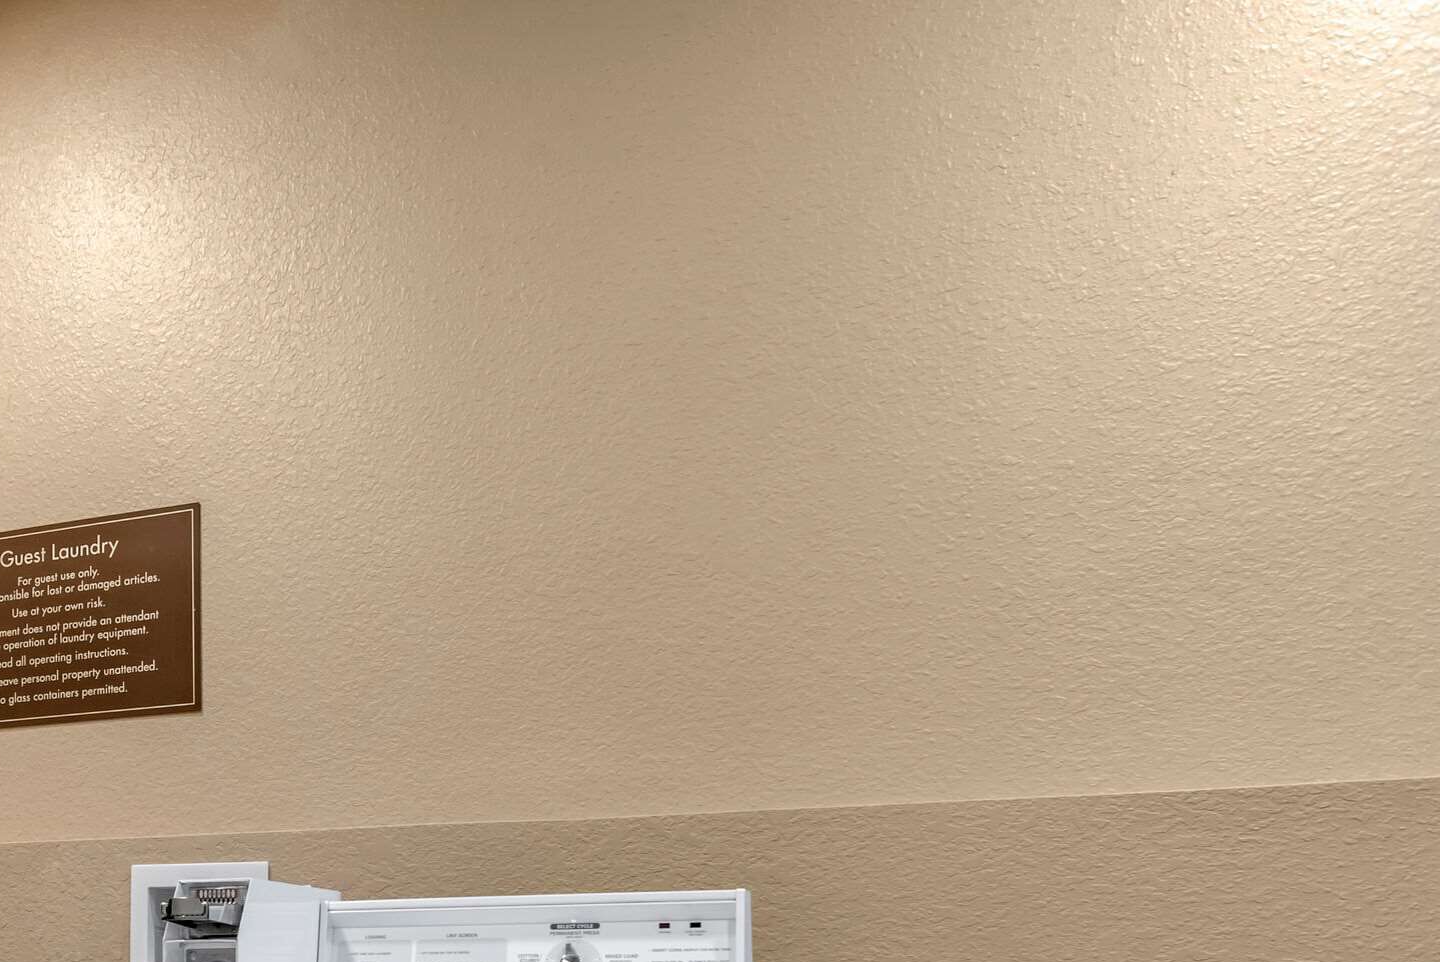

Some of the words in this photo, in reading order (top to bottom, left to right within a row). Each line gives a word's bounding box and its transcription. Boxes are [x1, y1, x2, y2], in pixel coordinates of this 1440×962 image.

[0, 547, 46, 568] Guest
[52, 535, 119, 560] Laundry
[17, 576, 32, 587] For
[34, 572, 58, 585] guest
[60, 572, 75, 580] use
[78, 566, 99, 580] only.
[32, 587, 44, 597] for
[47, 585, 62, 595] lost
[77, 576, 120, 591] damaged
[124, 572, 160, 585] articles.
[11, 607, 28, 618] Use
[30, 606, 39, 615] at
[41, 605, 62, 616] your
[64, 602, 83, 611] own
[86, 596, 106, 608] risk.
[22, 623, 43, 634] does
[45, 622, 61, 634] not
[63, 617, 96, 632] provide
[114, 609, 159, 623] attendant
[3, 637, 45, 652] operation
[48, 633, 57, 644] of
[60, 630, 94, 644] laundry
[97, 626, 149, 640] equipment.
[15, 655, 26, 666] all
[28, 652, 71, 667] operating
[75, 648, 128, 660] instructions.
[21, 670, 58, 686] personal
[62, 668, 100, 682] property
[104, 660, 158, 675] unattended.
[8, 692, 30, 706] glass
[33, 688, 78, 701] containers
[82, 683, 128, 698] permitted.
